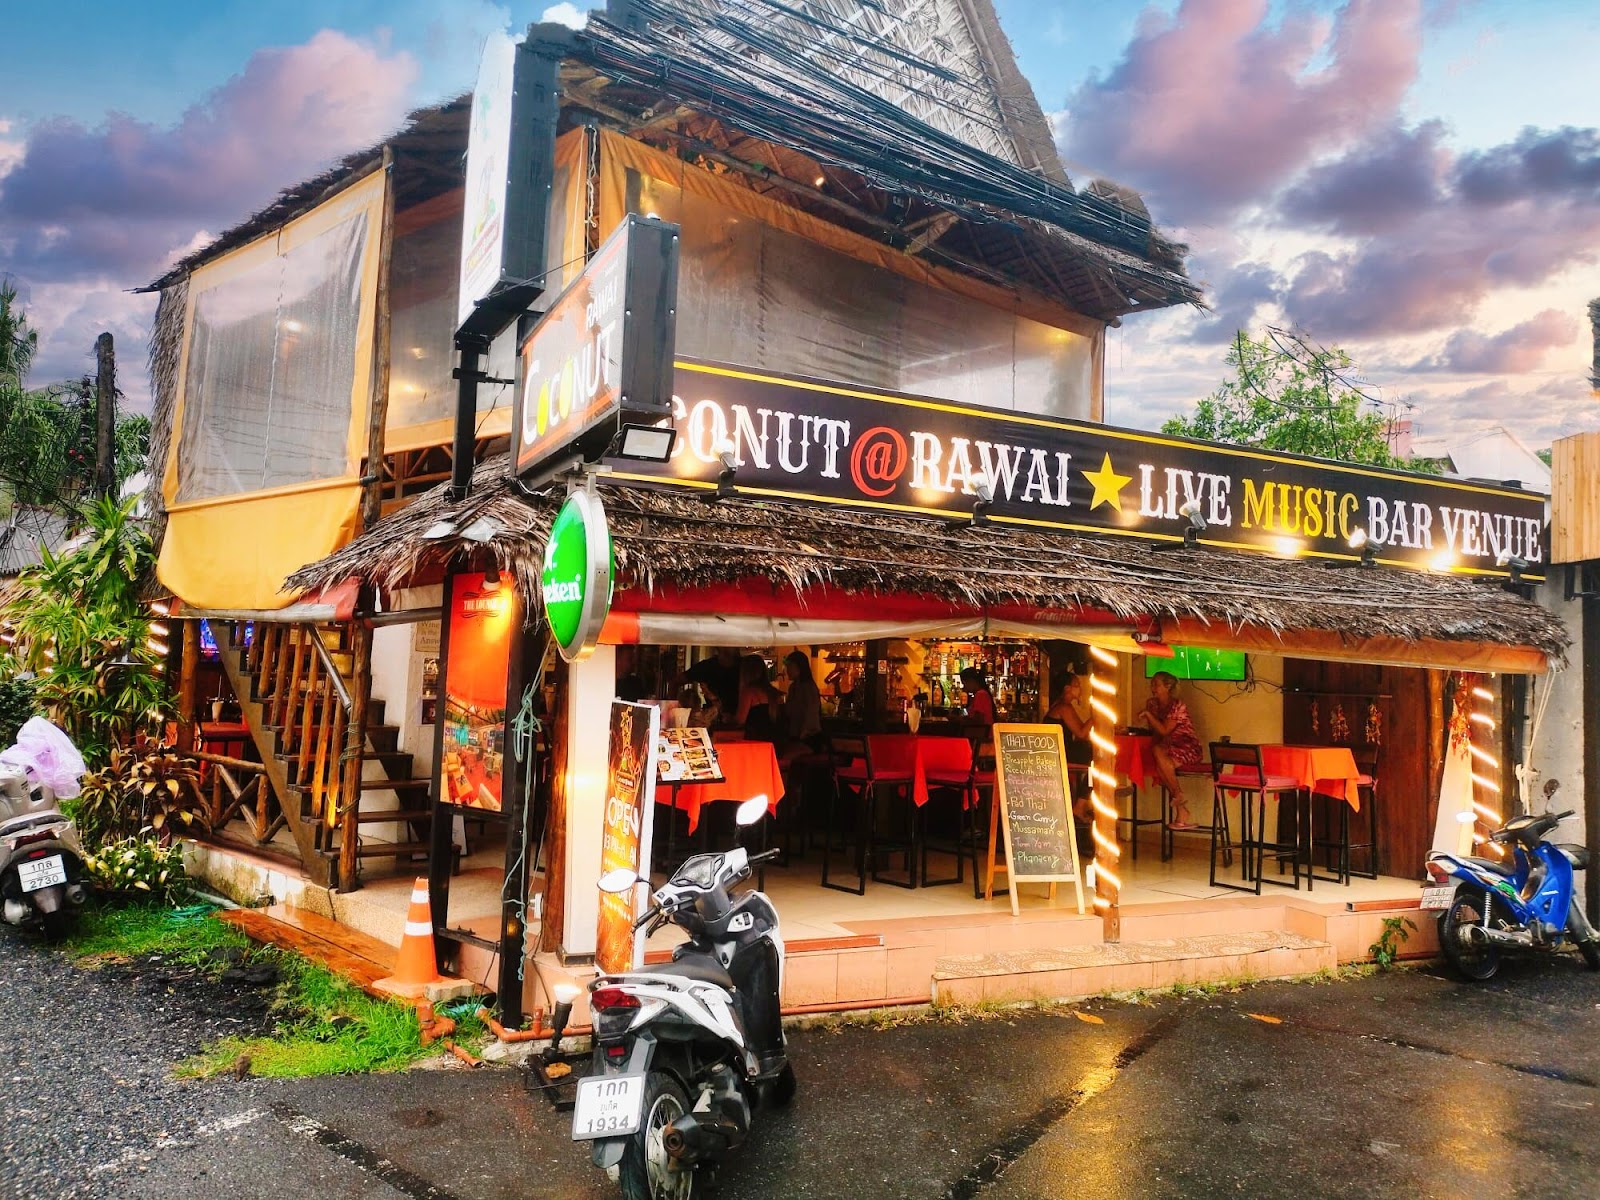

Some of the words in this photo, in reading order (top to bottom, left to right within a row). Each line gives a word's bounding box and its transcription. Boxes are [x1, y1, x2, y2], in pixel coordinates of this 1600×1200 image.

[1139, 463, 1232, 527] LIVE
[1241, 478, 1360, 541] MUSIC
[1367, 496, 1435, 550] BAR
[1438, 505, 1542, 563] VENUE
[1006, 734, 1026, 748] THAI
[1028, 735, 1055, 749] FOOD
[1026, 797, 1047, 811] Thai
[608, 796, 639, 839] OPEN
[1010, 810, 1031, 820] Green
[1013, 821, 1055, 836] Mussaman
[30, 876, 58, 888] 2730
[596, 1080, 628, 1097] 1กก
[587, 1115, 629, 1132] 1934
